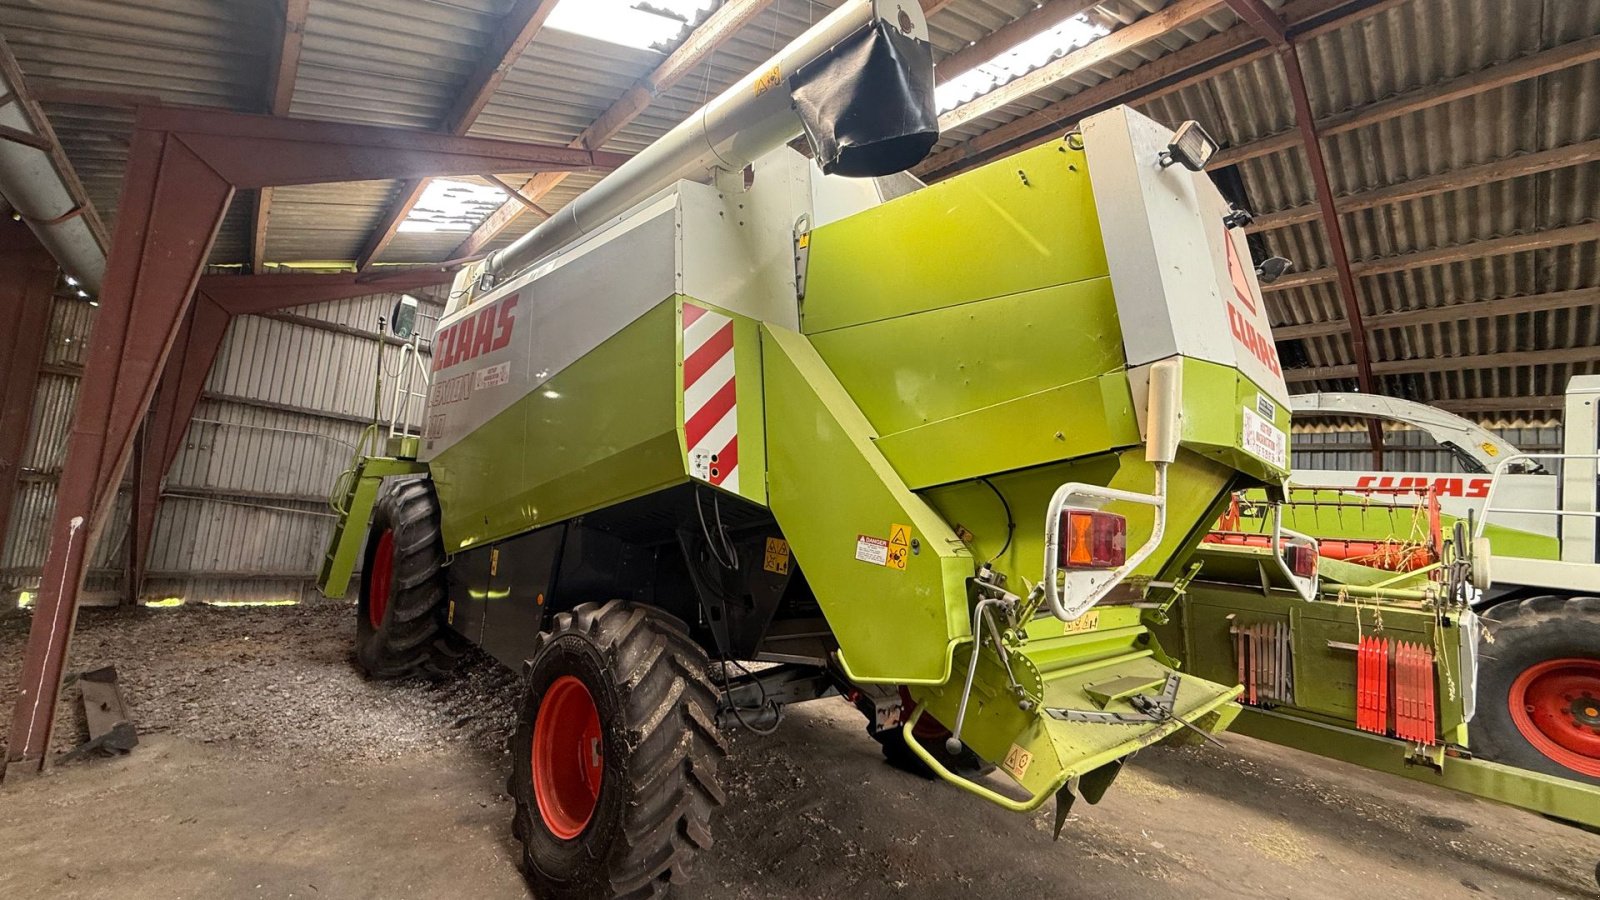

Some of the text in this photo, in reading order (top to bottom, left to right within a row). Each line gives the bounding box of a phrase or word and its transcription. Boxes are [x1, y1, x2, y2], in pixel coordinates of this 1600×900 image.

[432, 293, 520, 372] CLAAS
[1226, 300, 1281, 379] CLAAS
[1356, 476, 1493, 498] CLAAS
